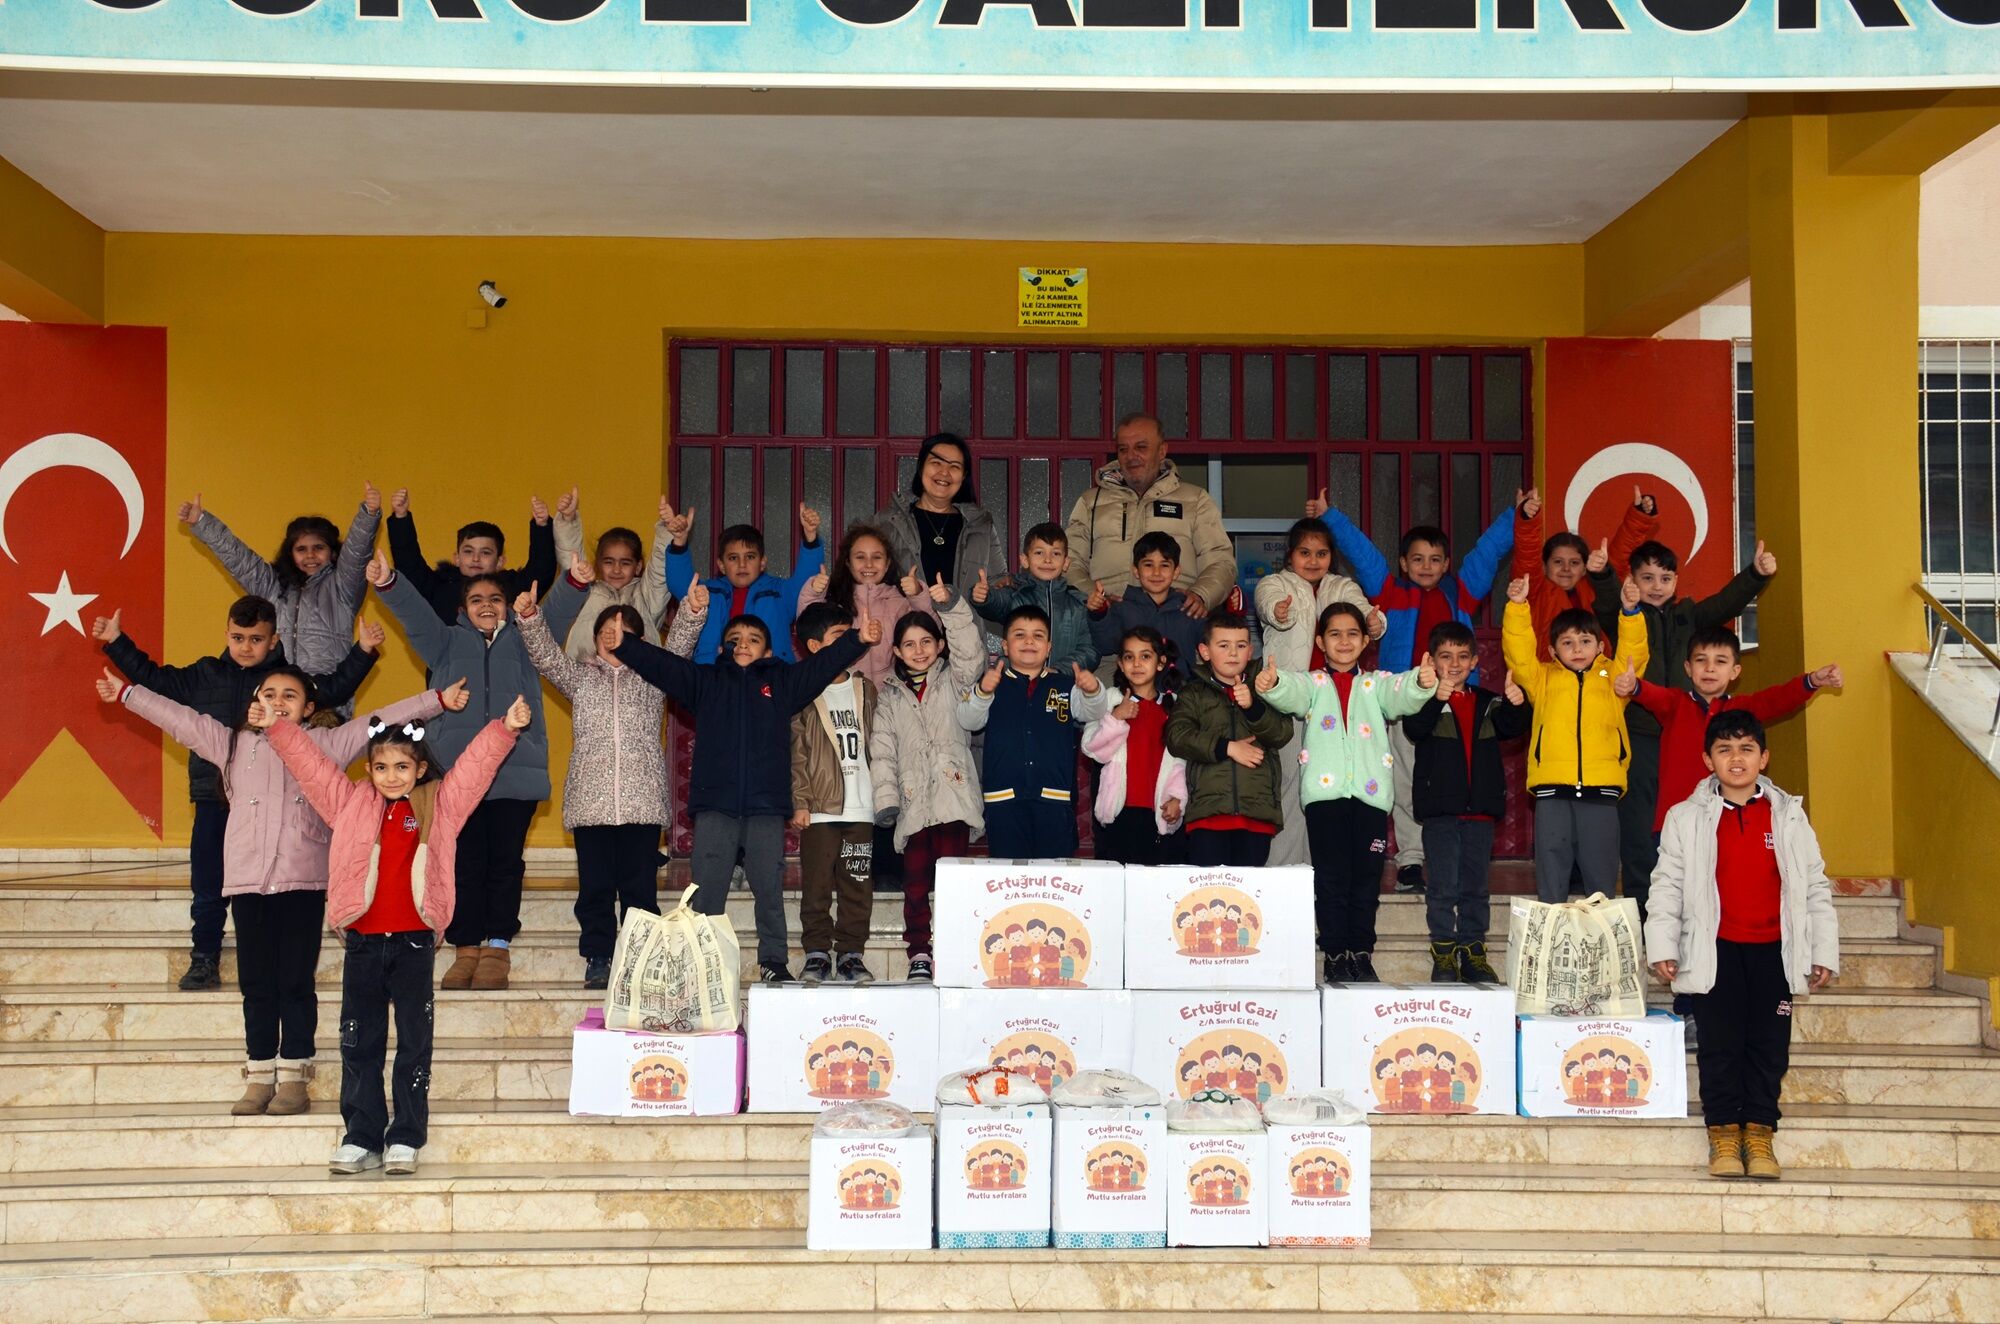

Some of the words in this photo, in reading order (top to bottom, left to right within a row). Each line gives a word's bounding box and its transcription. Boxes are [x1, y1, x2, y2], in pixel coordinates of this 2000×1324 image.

[1189, 873, 1223, 884] Ertuğrul
[1225, 873, 1243, 883] Gazi
[985, 875, 1046, 893] Ertuğrul
[1051, 876, 1084, 895] Gazi
[1180, 1000, 1240, 1020] Ertuğrul
[1245, 1002, 1278, 1020] Gazi
[1374, 999, 1434, 1018] Ertuğrul
[1439, 1000, 1472, 1019] Gazi
[822, 1014, 857, 1025] Ertuğrul
[859, 1015, 877, 1026] Gazi
[1005, 1017, 1040, 1029] Ertuğrul
[1041, 1018, 1060, 1030] Gazi
[1577, 1022, 1611, 1033] Ertuğrul
[1613, 1023, 1632, 1033] Gazi
[666, 1040, 685, 1051] Gazi
[968, 1124, 1002, 1135] Ertuğrul
[1004, 1124, 1023, 1136] Gazi
[1088, 1125, 1122, 1136] Ertuğrul
[1124, 1125, 1144, 1137] Gazi
[1291, 1131, 1325, 1143] Ertuğrul
[1327, 1132, 1346, 1143] Gazi
[840, 1143, 876, 1154] Ertuğrul
[878, 1143, 896, 1154] Gazi
[1190, 1140, 1224, 1150] Ertuğrul
[1226, 1140, 1245, 1151] Gazi
